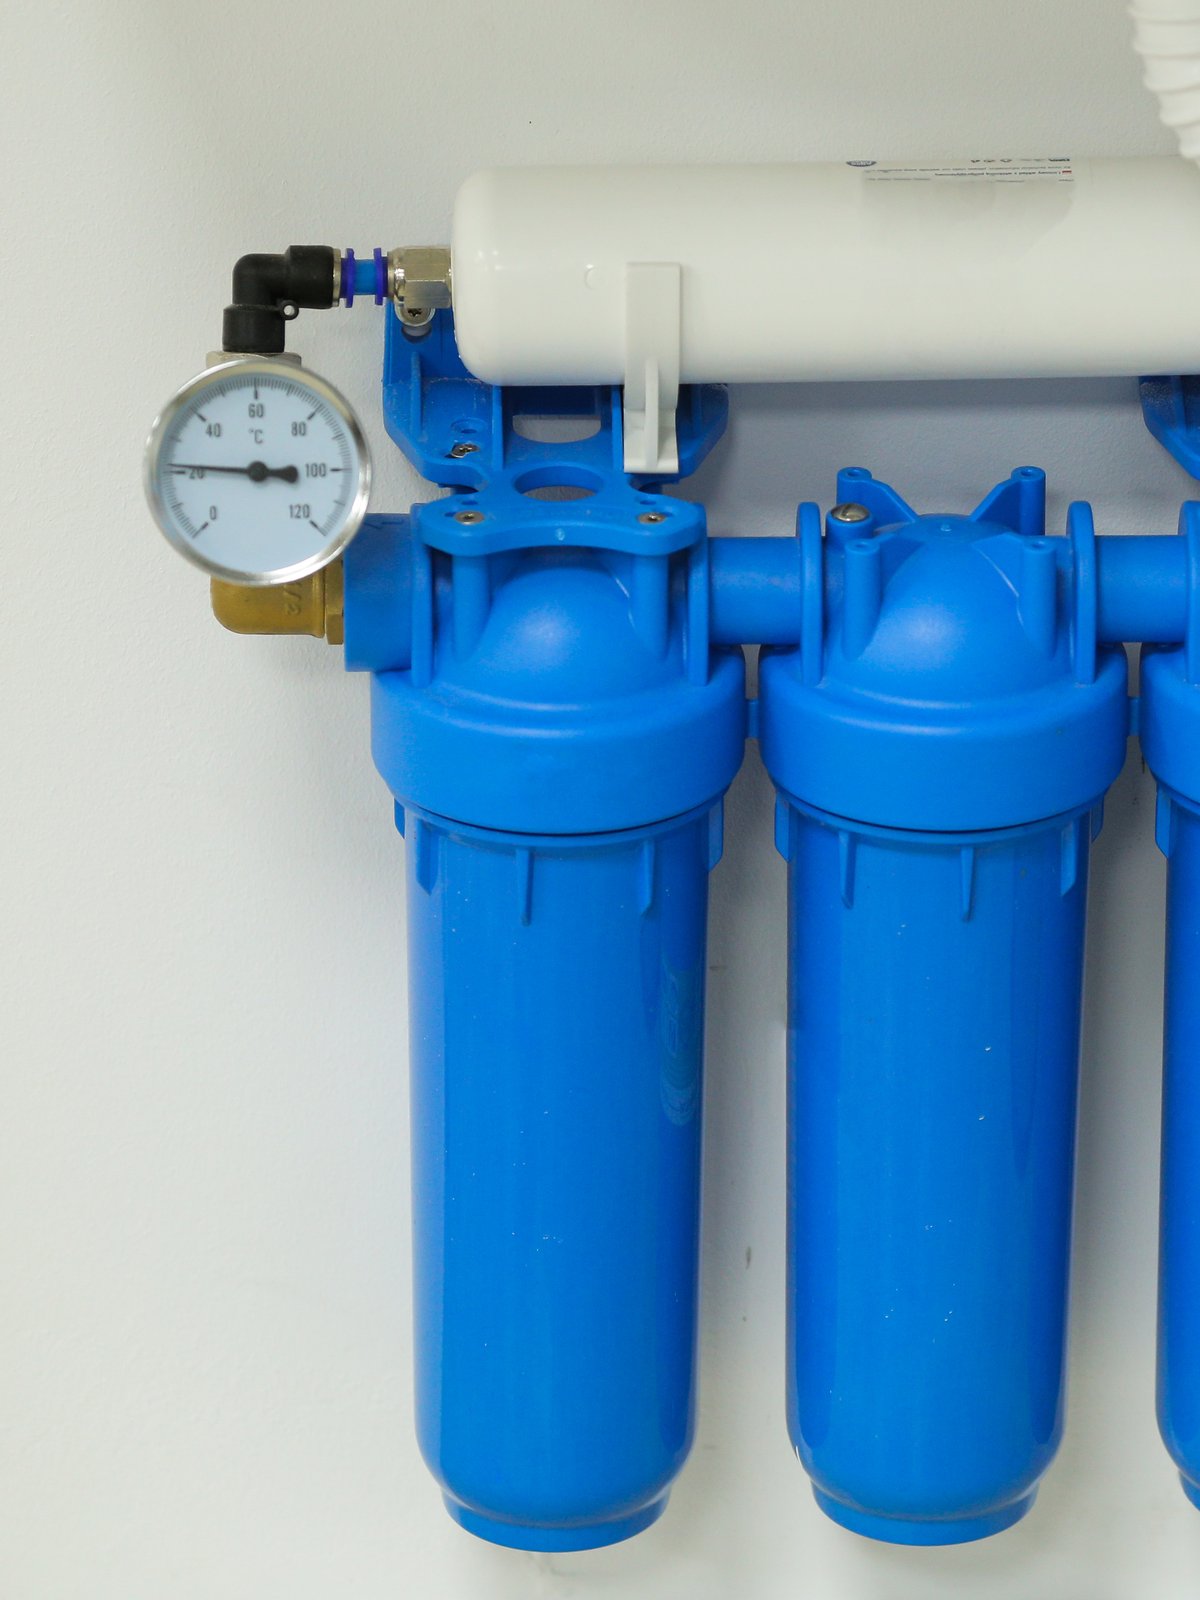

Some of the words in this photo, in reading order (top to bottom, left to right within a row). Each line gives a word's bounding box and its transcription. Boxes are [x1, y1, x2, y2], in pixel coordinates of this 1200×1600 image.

[248, 403, 265, 418] 60
[205, 422, 222, 438] 40
[291, 421, 307, 437] 80
[305, 462, 327, 478] 100
[208, 505, 218, 521] 0
[289, 504, 311, 519] 120
